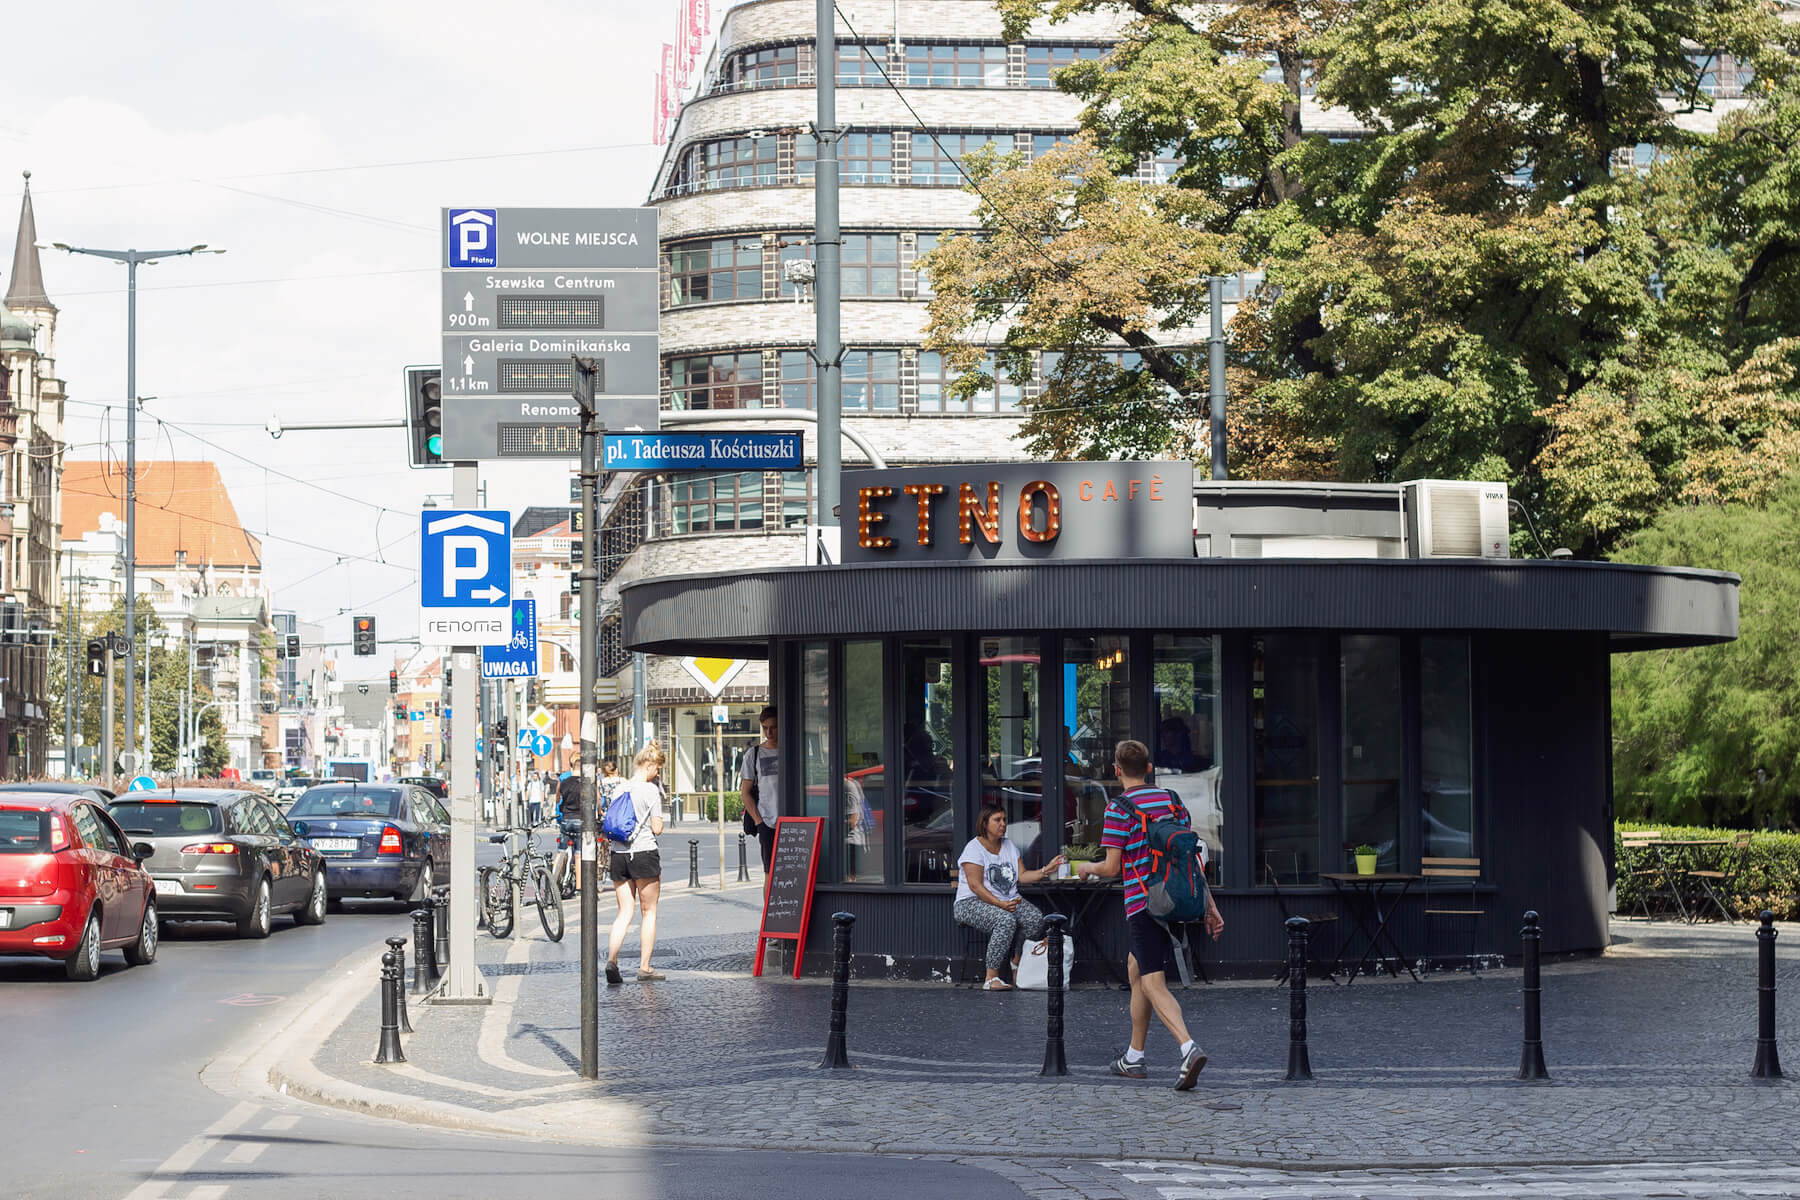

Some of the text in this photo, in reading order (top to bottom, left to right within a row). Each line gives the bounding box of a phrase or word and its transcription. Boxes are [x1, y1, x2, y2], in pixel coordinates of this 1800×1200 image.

[517, 232, 638, 246] WOLNE MIEJSCA
[486, 276, 615, 289] Szewska Centrum
[469, 339, 631, 352] Galeria Dominikańska
[607, 438, 794, 463] pl. Tadeusza Kościuszki
[858, 480, 1063, 548] ETNO
[484, 661, 529, 676] UWAGA
